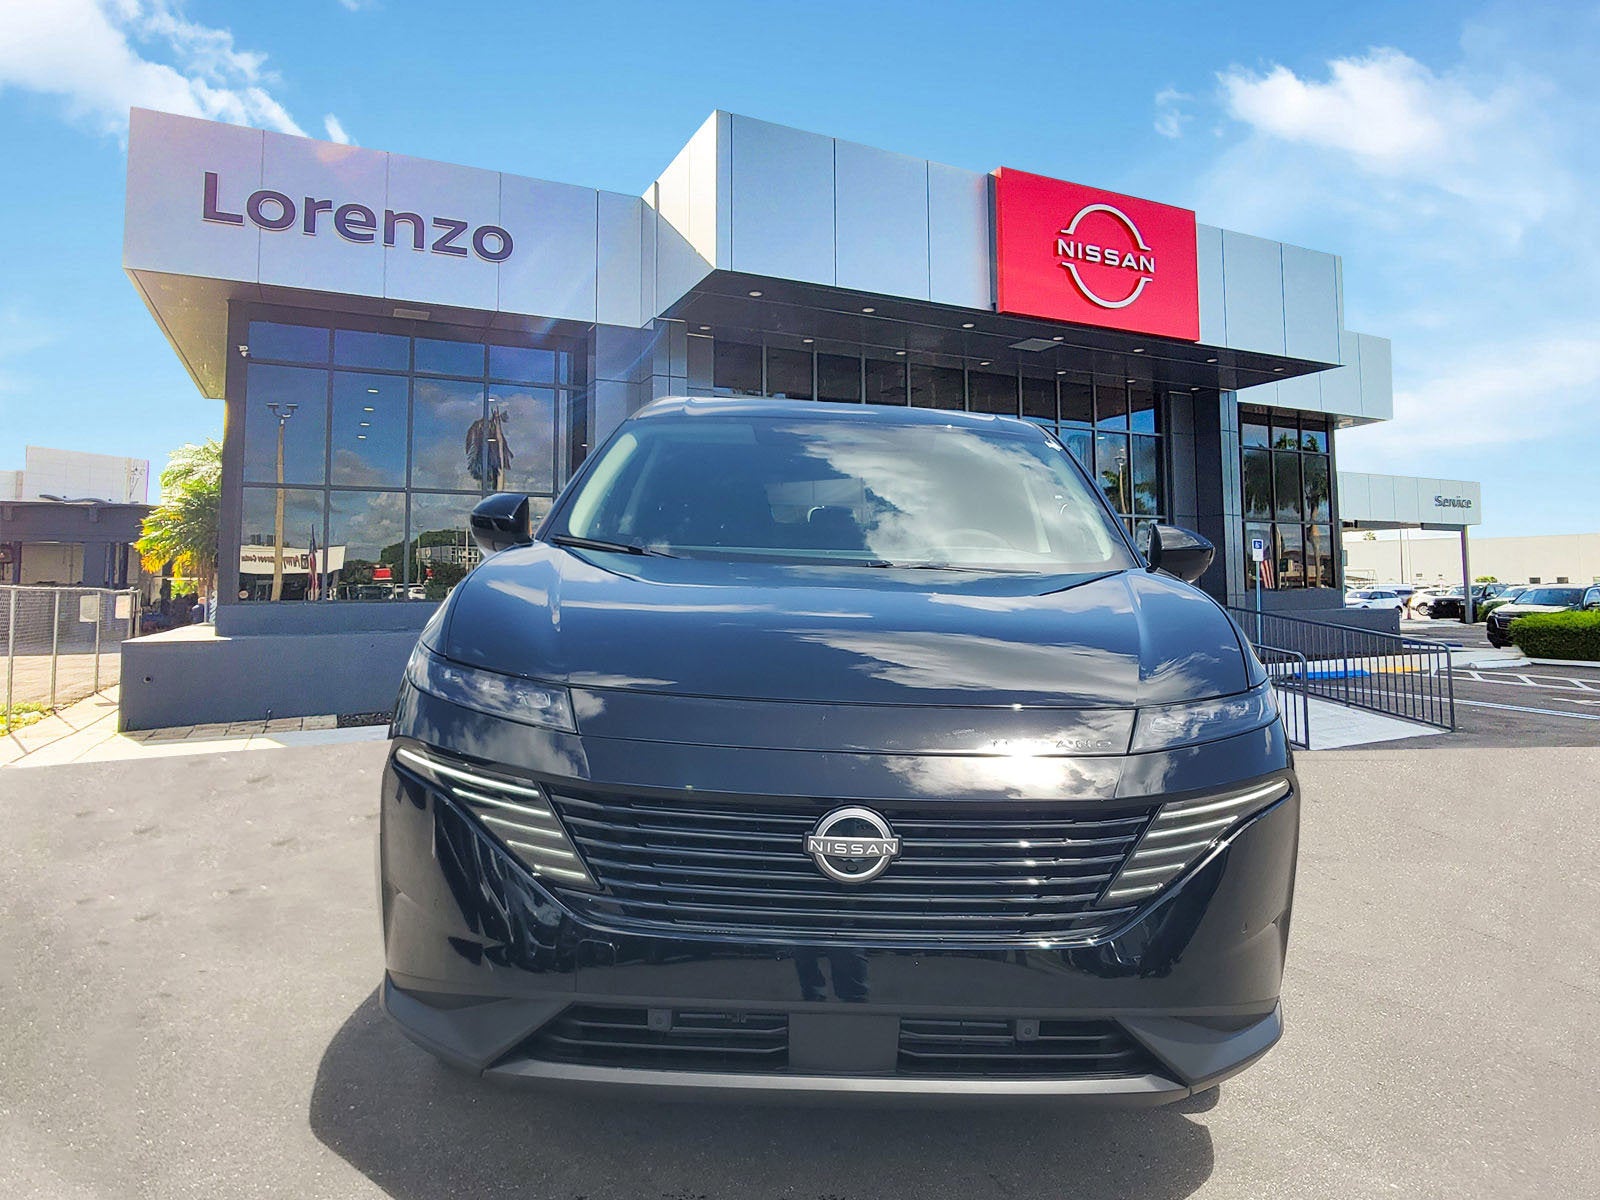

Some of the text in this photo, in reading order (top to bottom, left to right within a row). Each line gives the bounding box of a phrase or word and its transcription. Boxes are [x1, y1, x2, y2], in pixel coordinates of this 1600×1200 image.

[203, 171, 514, 262] Lorenzo
[1057, 238, 1155, 273] NISSAN
[1434, 495, 1472, 508] Service
[809, 840, 896, 855] NISSAN
